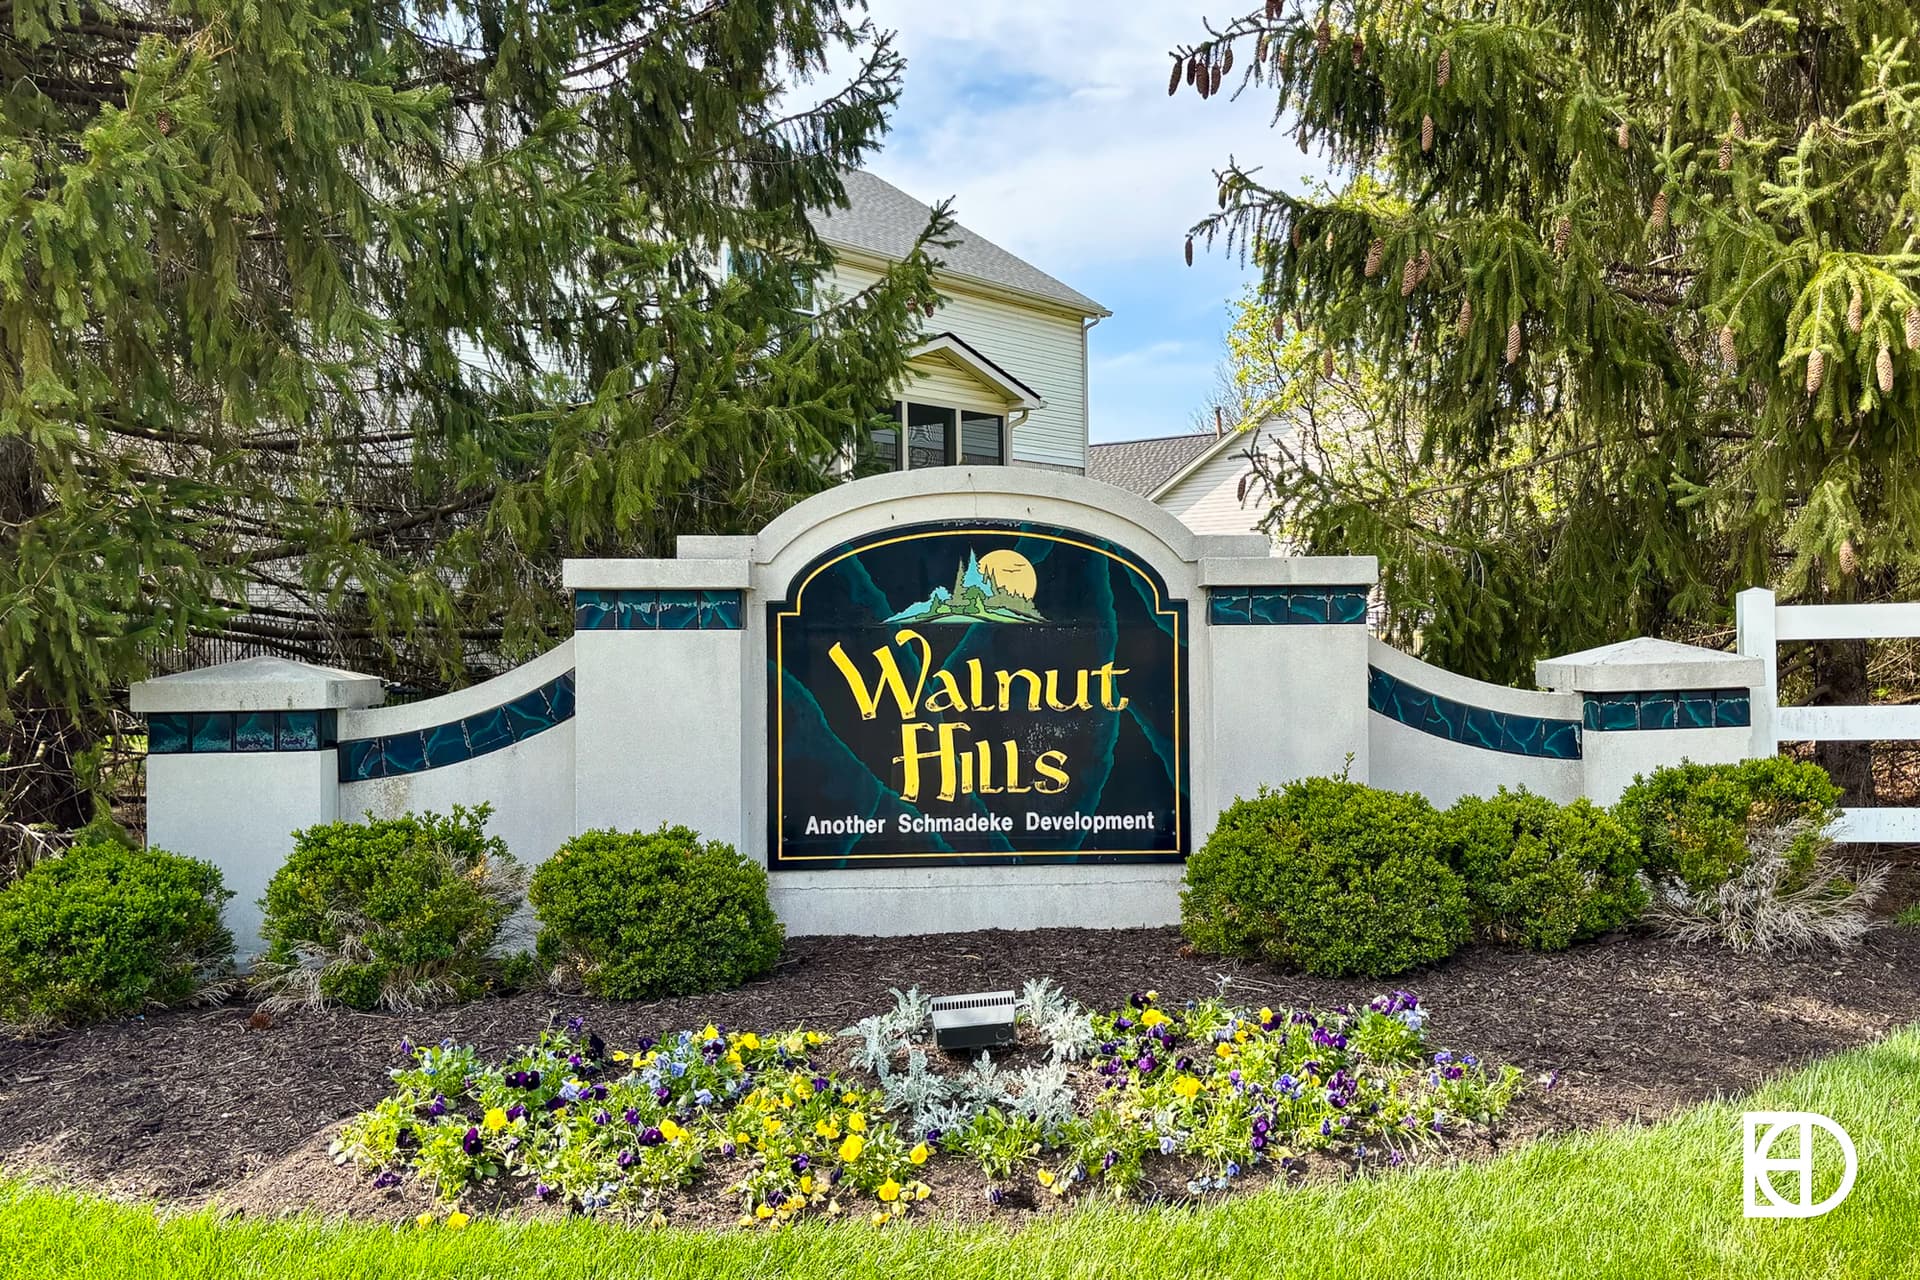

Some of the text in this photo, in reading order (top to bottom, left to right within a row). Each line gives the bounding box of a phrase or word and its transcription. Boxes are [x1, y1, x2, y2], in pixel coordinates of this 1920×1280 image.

[828, 629, 1130, 720] Walnut
[805, 811, 1155, 835] Another Schmadeke Development
